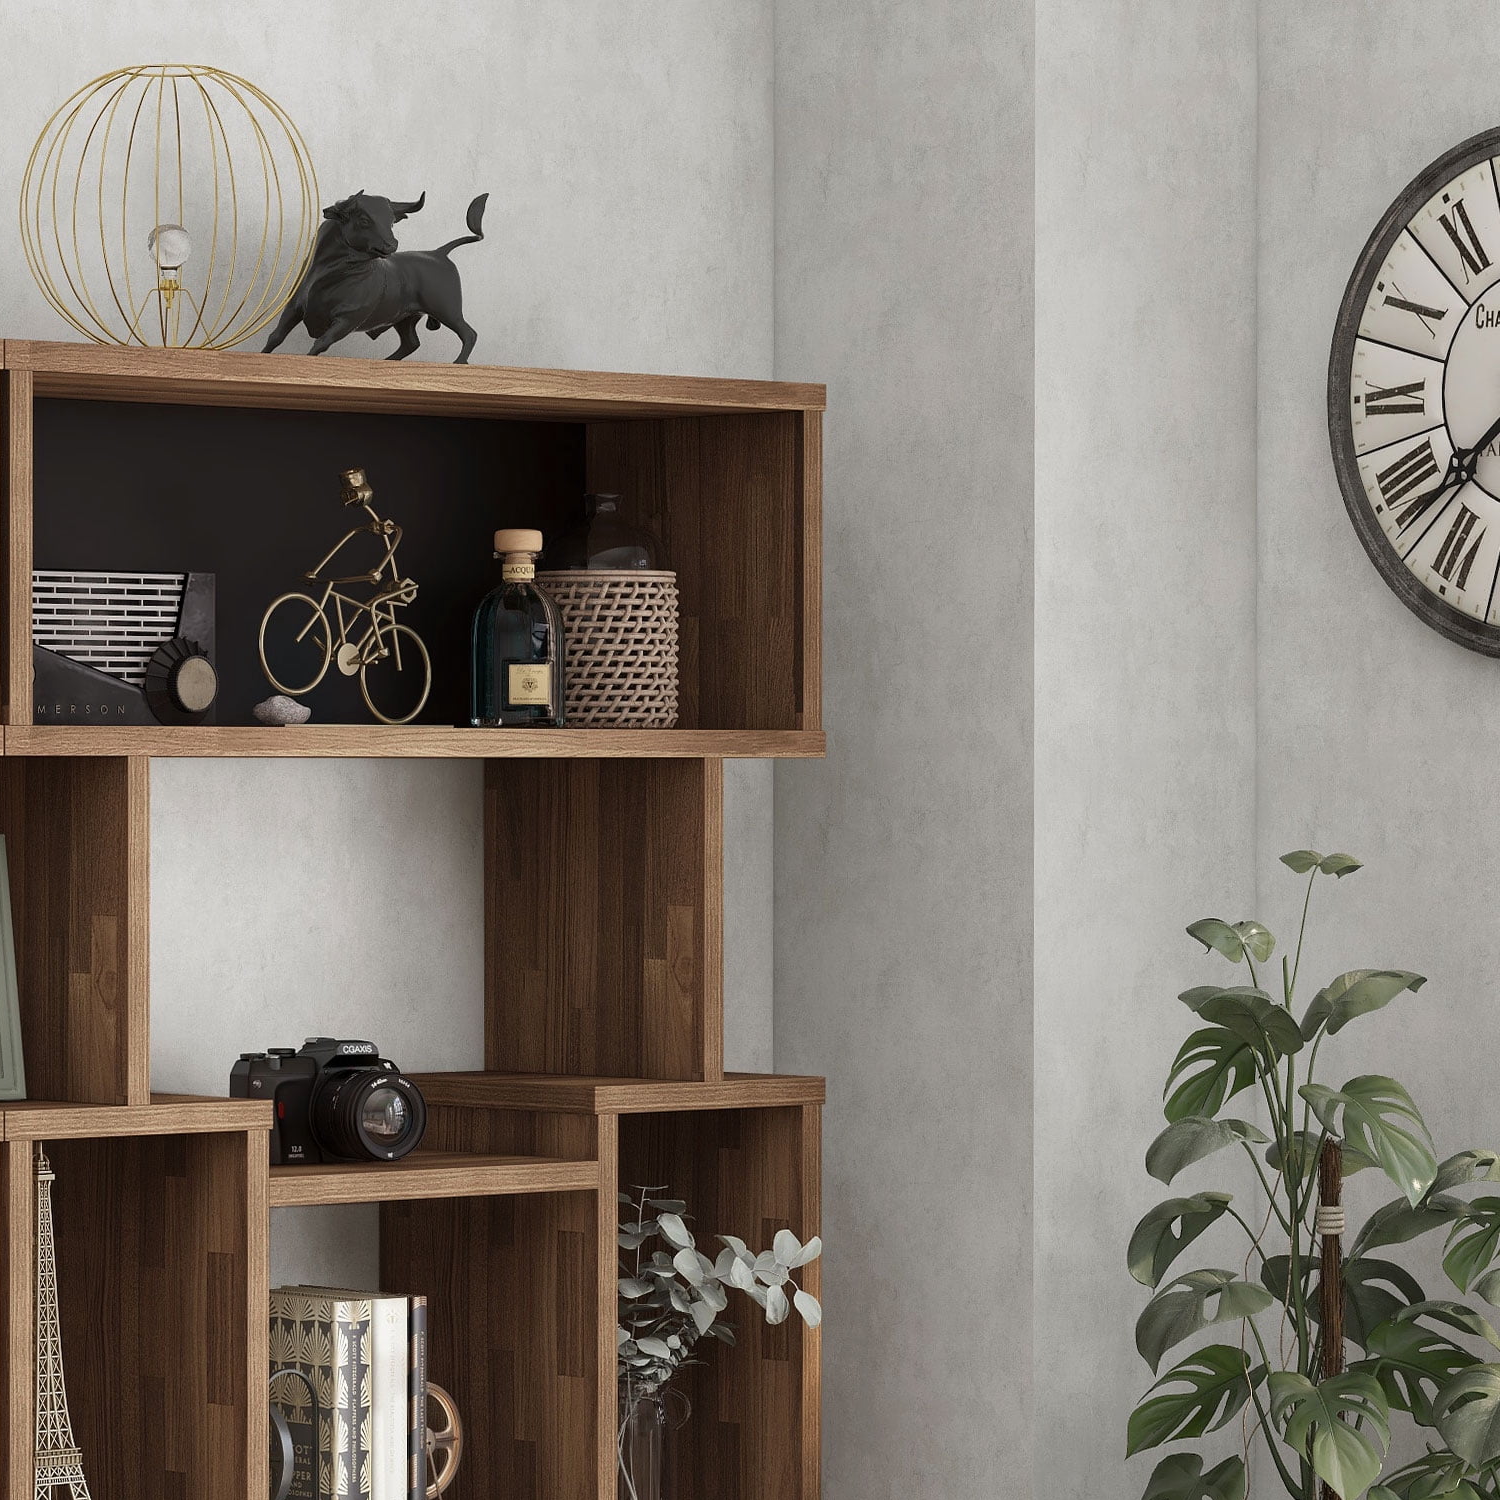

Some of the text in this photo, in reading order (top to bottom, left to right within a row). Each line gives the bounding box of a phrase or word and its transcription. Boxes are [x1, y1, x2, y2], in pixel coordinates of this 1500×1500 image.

[1382, 281, 1449, 339] X
[37, 704, 125, 714] MERSON
[342, 1045, 373, 1054] CGAXIS
